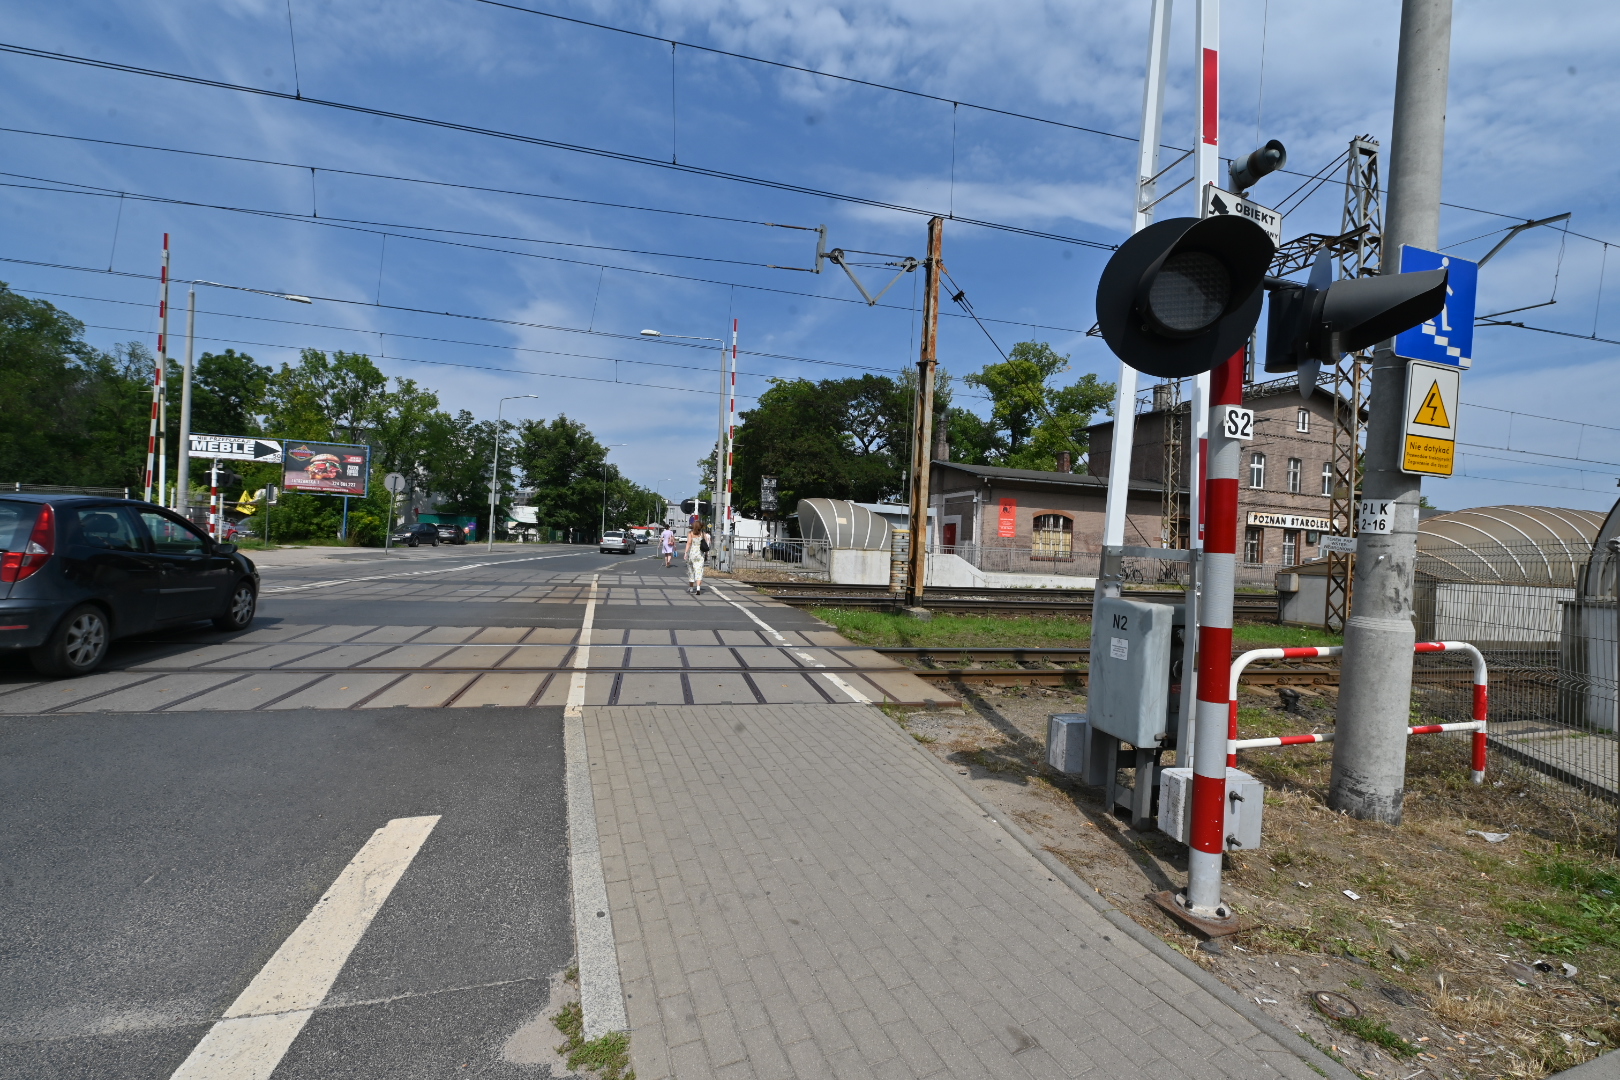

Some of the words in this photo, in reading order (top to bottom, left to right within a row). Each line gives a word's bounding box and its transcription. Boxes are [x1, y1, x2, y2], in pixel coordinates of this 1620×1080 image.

[1235, 202, 1276, 226] OBIEKT
[1227, 409, 1251, 437] S2
[191, 440, 255, 454] MEBLE
[1409, 441, 1422, 451] Nie
[1424, 444, 1450, 455] dotykać
[1361, 518, 1386, 531] 2-16
[1112, 614, 1128, 631] N2
